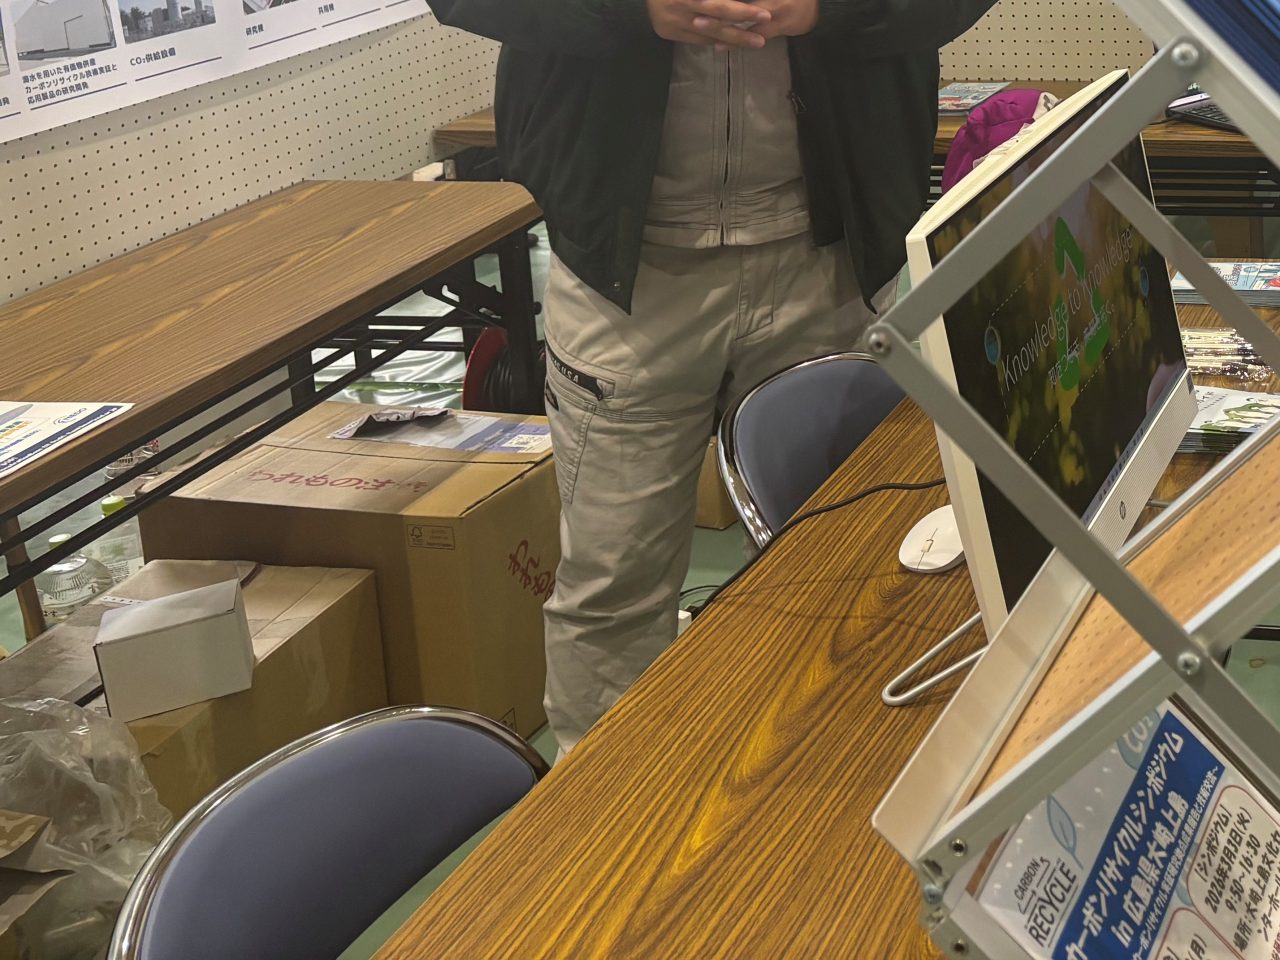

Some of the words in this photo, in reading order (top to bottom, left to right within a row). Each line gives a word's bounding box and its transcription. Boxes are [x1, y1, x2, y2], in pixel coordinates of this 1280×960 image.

[1003, 302, 1067, 391] Knowledge
[1068, 288, 1080, 314] to
[1014, 859, 1040, 900] CARBON
[1066, 730, 1185, 960] カーボンリサイクルシンポジウム
[1111, 921, 1134, 948] in
[1123, 790, 1190, 929] 広島県大崎上島
[1204, 806, 1253, 914] 2026年3月3日(火)
[1028, 861, 1077, 948] RECYCLE
